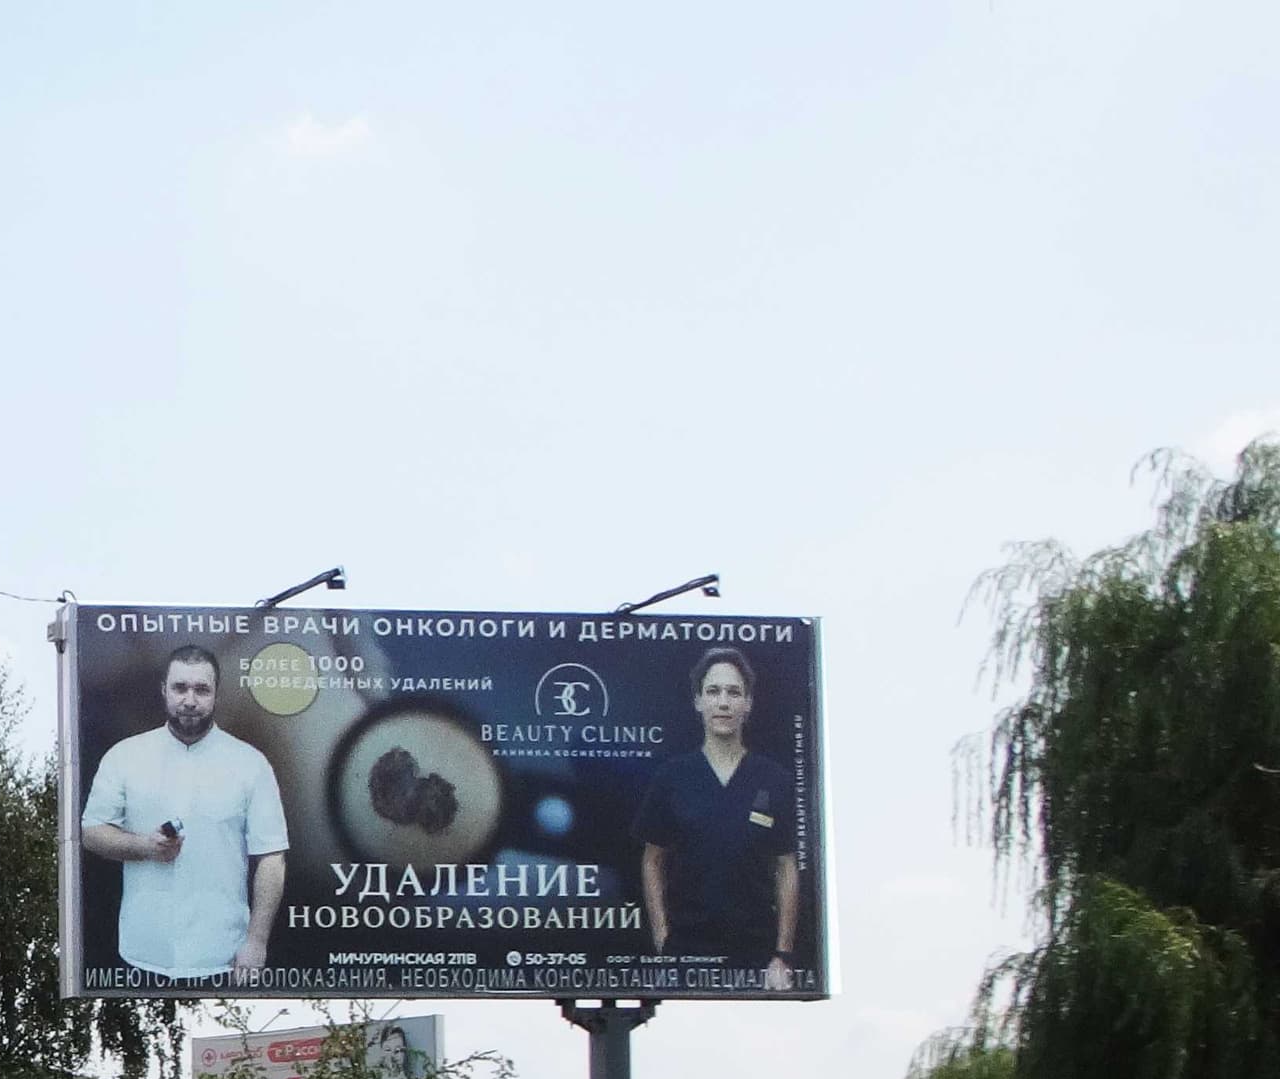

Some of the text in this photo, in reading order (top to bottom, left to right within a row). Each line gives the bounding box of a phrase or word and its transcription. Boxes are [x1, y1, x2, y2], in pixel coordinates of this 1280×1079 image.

[96, 613, 794, 643] ОПЫТНЫЕ ВРАЧИ ОНКОЛОГИ И ДЕРМАТОЛОГИ
[239, 655, 365, 673] БОЛЕЕ 1000
[239, 675, 494, 692] ПРОВЕДЕННЫХ УДАЛЕНИЙ
[481, 724, 664, 744] BEAUTY CLINIC
[331, 863, 601, 903] УДАЛЕНИЕ
[288, 902, 642, 929] НОВООБРАЗОВАНИЙ
[329, 952, 446, 965] МИЧУРИНСКАЯ
[525, 953, 587, 966] 50-37-05
[401, 968, 527, 990] НЕОБХОДИМА
[534, 968, 679, 990] КОНСУЛЬТАЦИЯ
[686, 968, 816, 991] СПЕЦИАЛСТА
